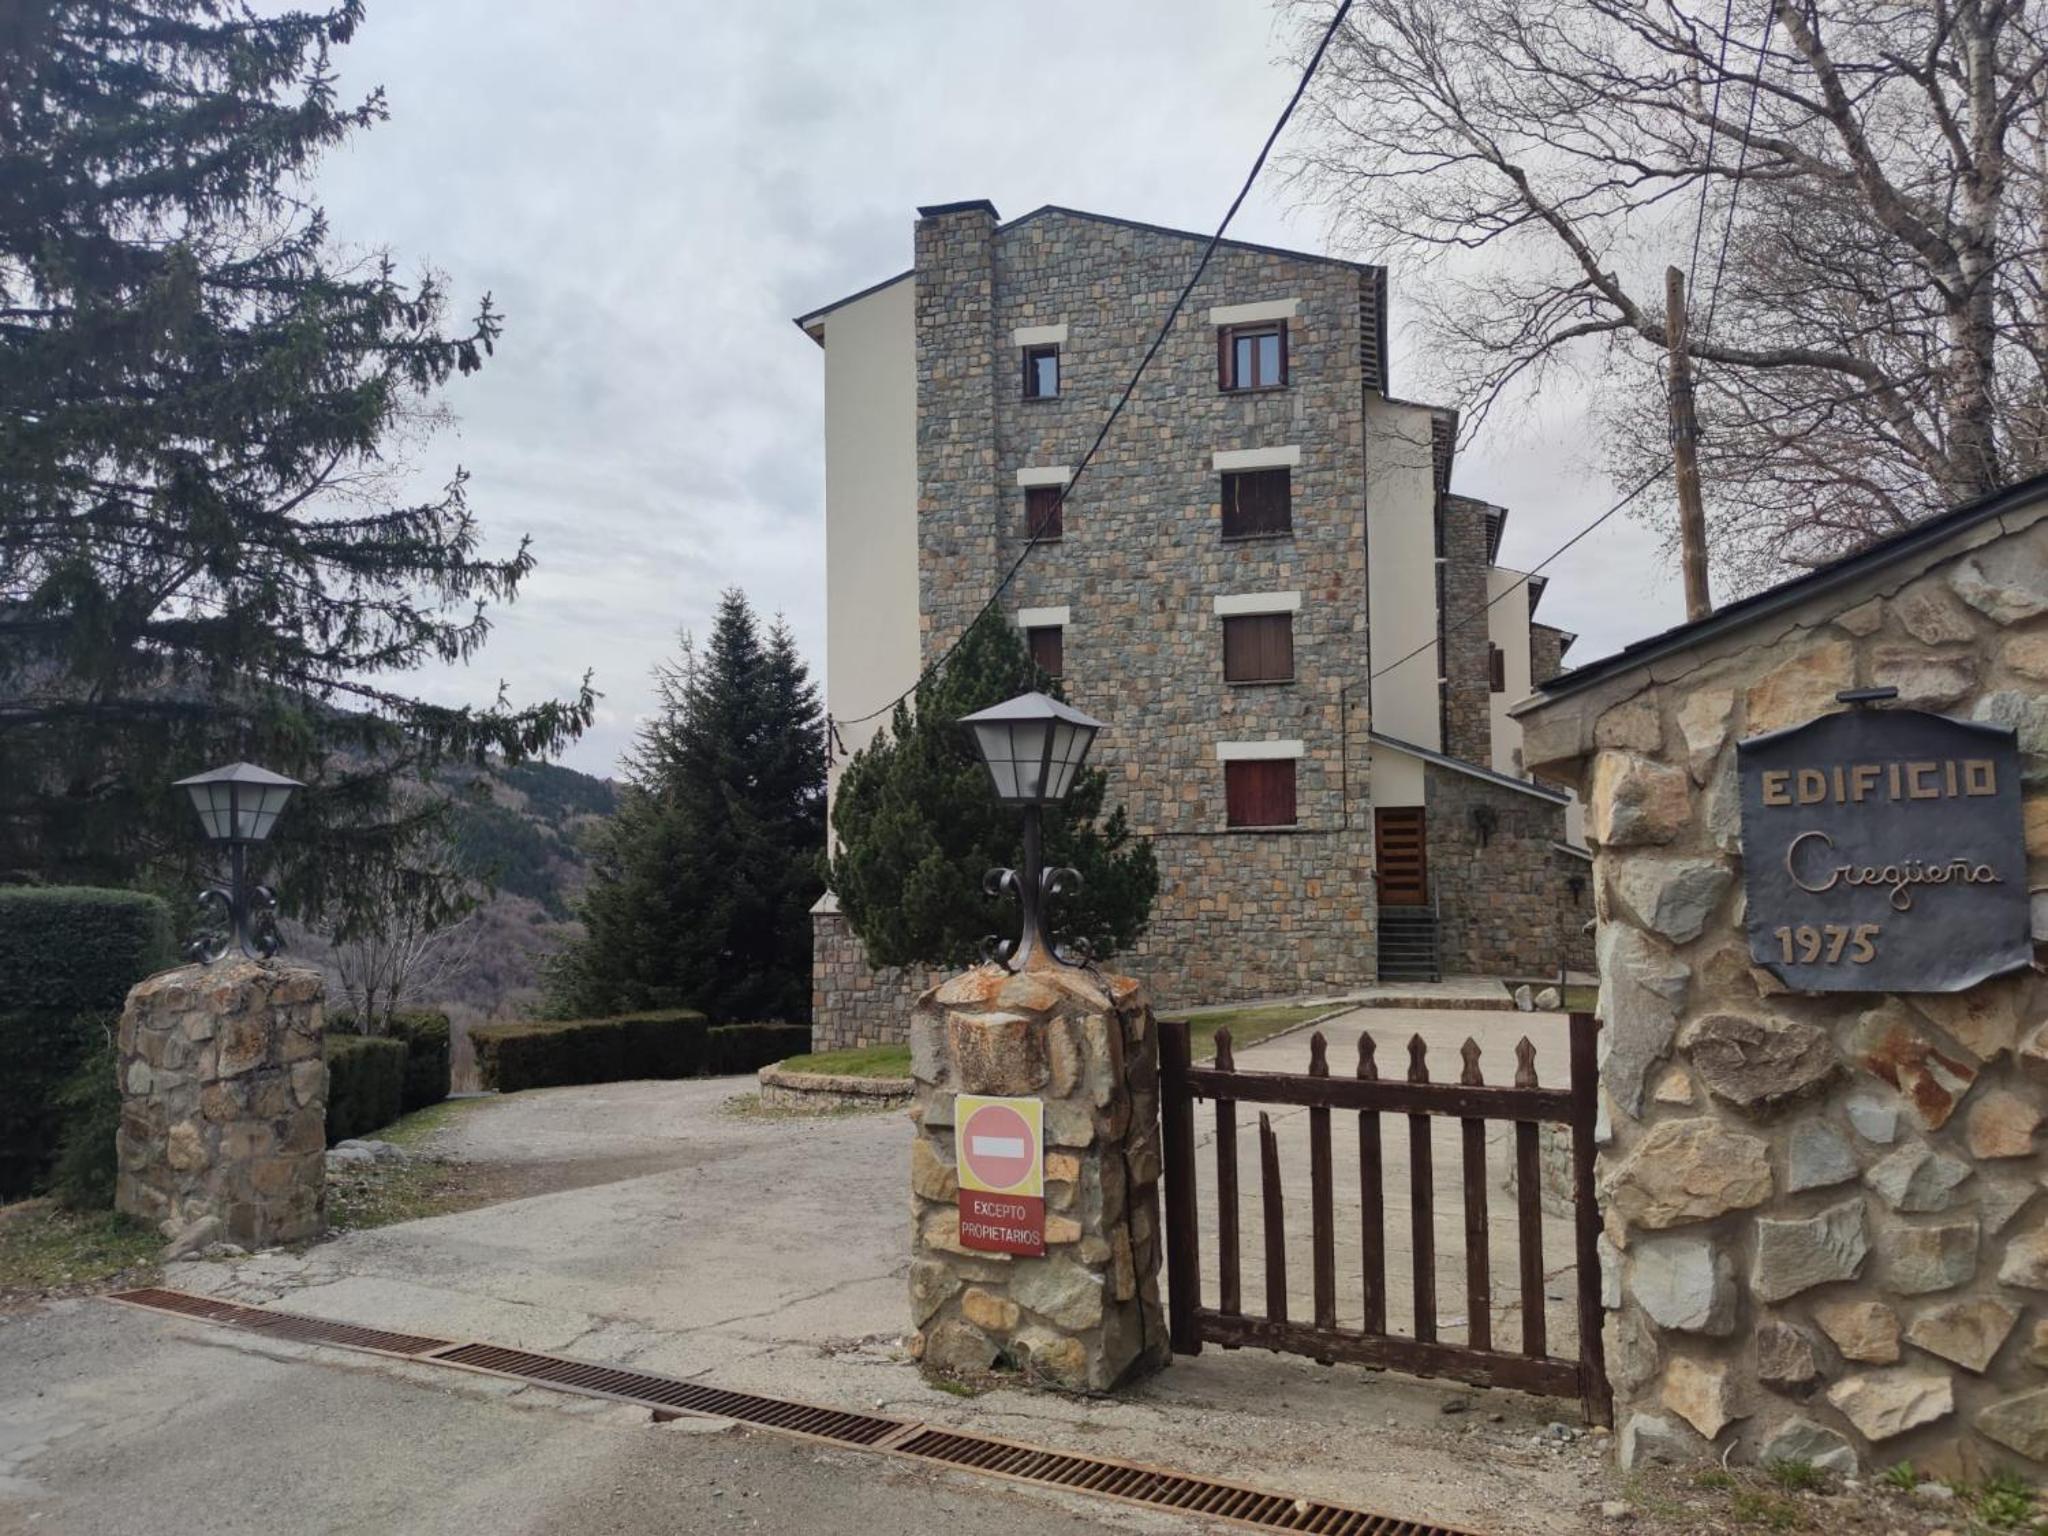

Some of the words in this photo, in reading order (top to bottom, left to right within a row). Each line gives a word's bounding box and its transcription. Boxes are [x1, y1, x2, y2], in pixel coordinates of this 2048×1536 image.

[1762, 759, 1997, 806] EDIFICIO
[1787, 831, 2004, 911] Cregüeña
[1774, 924, 1881, 965] 1975
[974, 1200, 1026, 1221] EXCEPTO
[962, 1221, 1041, 1246] PROPIETARIOS
